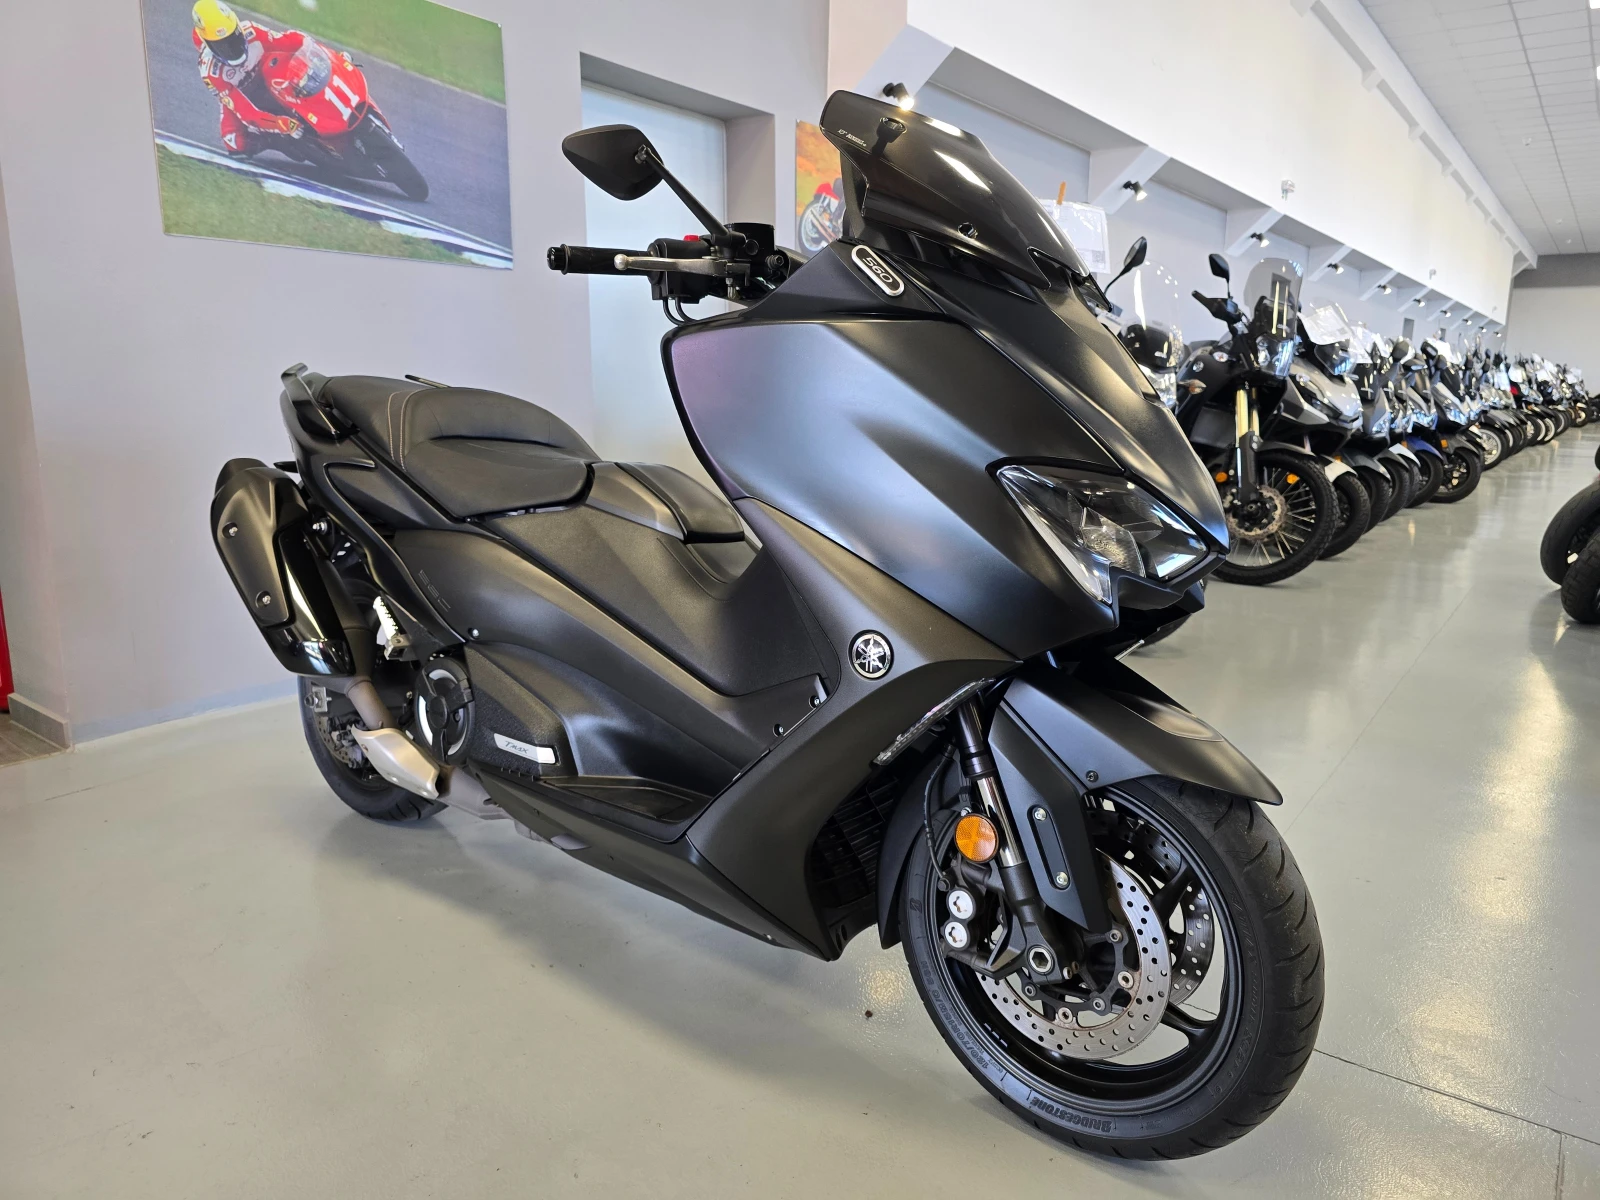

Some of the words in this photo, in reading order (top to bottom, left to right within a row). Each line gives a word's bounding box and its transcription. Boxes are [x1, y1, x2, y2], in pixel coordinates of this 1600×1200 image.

[324, 74, 360, 121] 11
[862, 256, 894, 283] 560
[504, 741, 530, 755] TMAX
[1030, 1096, 1113, 1133] BRIDGESTONE
